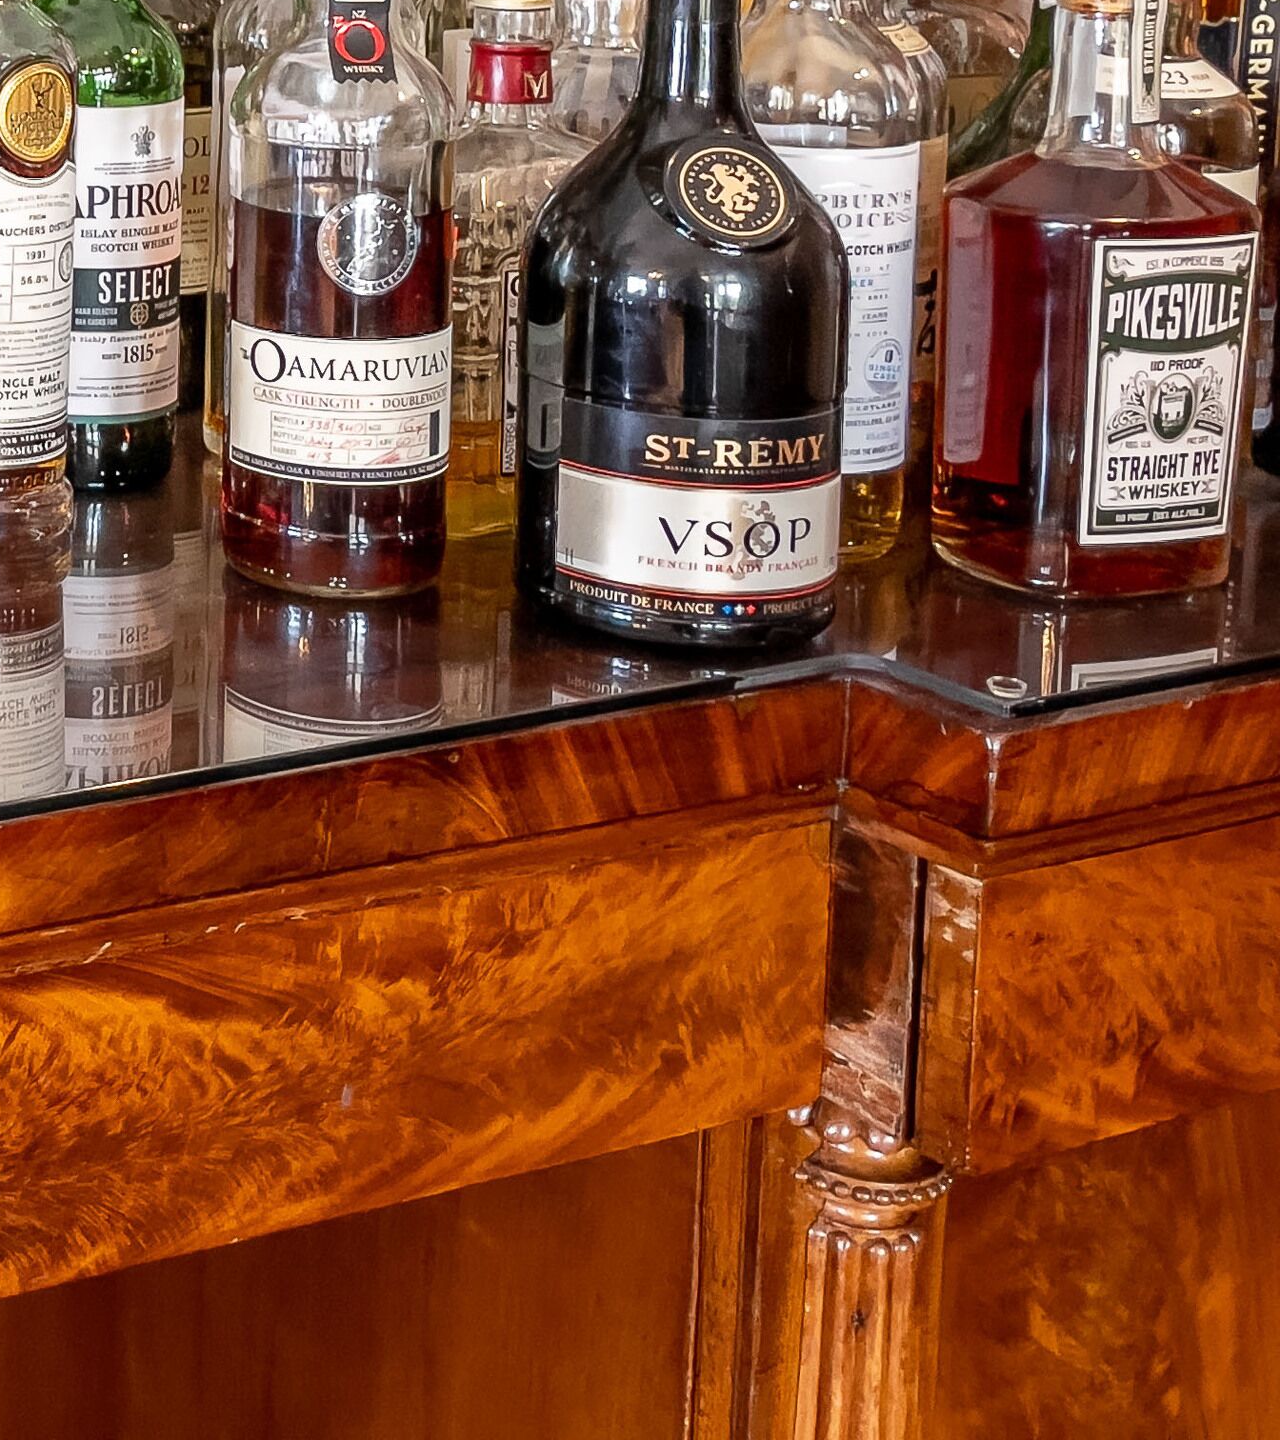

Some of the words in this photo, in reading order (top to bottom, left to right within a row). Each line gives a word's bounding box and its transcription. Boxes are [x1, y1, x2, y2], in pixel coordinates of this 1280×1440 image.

[1143, 14, 1157, 74] STRAIGHT
[1163, 70, 1189, 85] 23
[74, 175, 182, 220] APHROA
[815, 189, 912, 209] PBURN'S
[80, 229, 117, 238] ISLAY
[121, 225, 160, 237] SINGLE
[163, 219, 178, 232] MALT
[835, 213, 895, 229] OICE
[91, 242, 138, 252] SCOTCH
[142, 236, 174, 250] WHISKY
[845, 244, 884, 256] COTCH
[98, 265, 172, 304] SELECT
[1106, 281, 1242, 340] PIKESVILLE
[123, 343, 154, 364] 1815
[250, 338, 449, 383] OAMARUVIAN
[1168, 358, 1206, 371] PROOF
[39, 371, 61, 383] MALT
[34, 382, 65, 398] WHISKY
[253, 386, 282, 401] CASK
[286, 392, 360, 409] STRENGTH
[644, 433, 824, 467] ST-RÉMY
[1107, 452, 1189, 482] STRAIGHT
[1192, 448, 1221, 476] RYE
[1128, 481, 1200, 500] WHISKEY
[658, 516, 811, 558] VSOP
[637, 555, 698, 571] FRENCH
[705, 563, 764, 574] BRANDY
[569, 578, 628, 604] PRODUIT
[630, 595, 651, 609] DE
[653, 598, 715, 615] FRANCE
